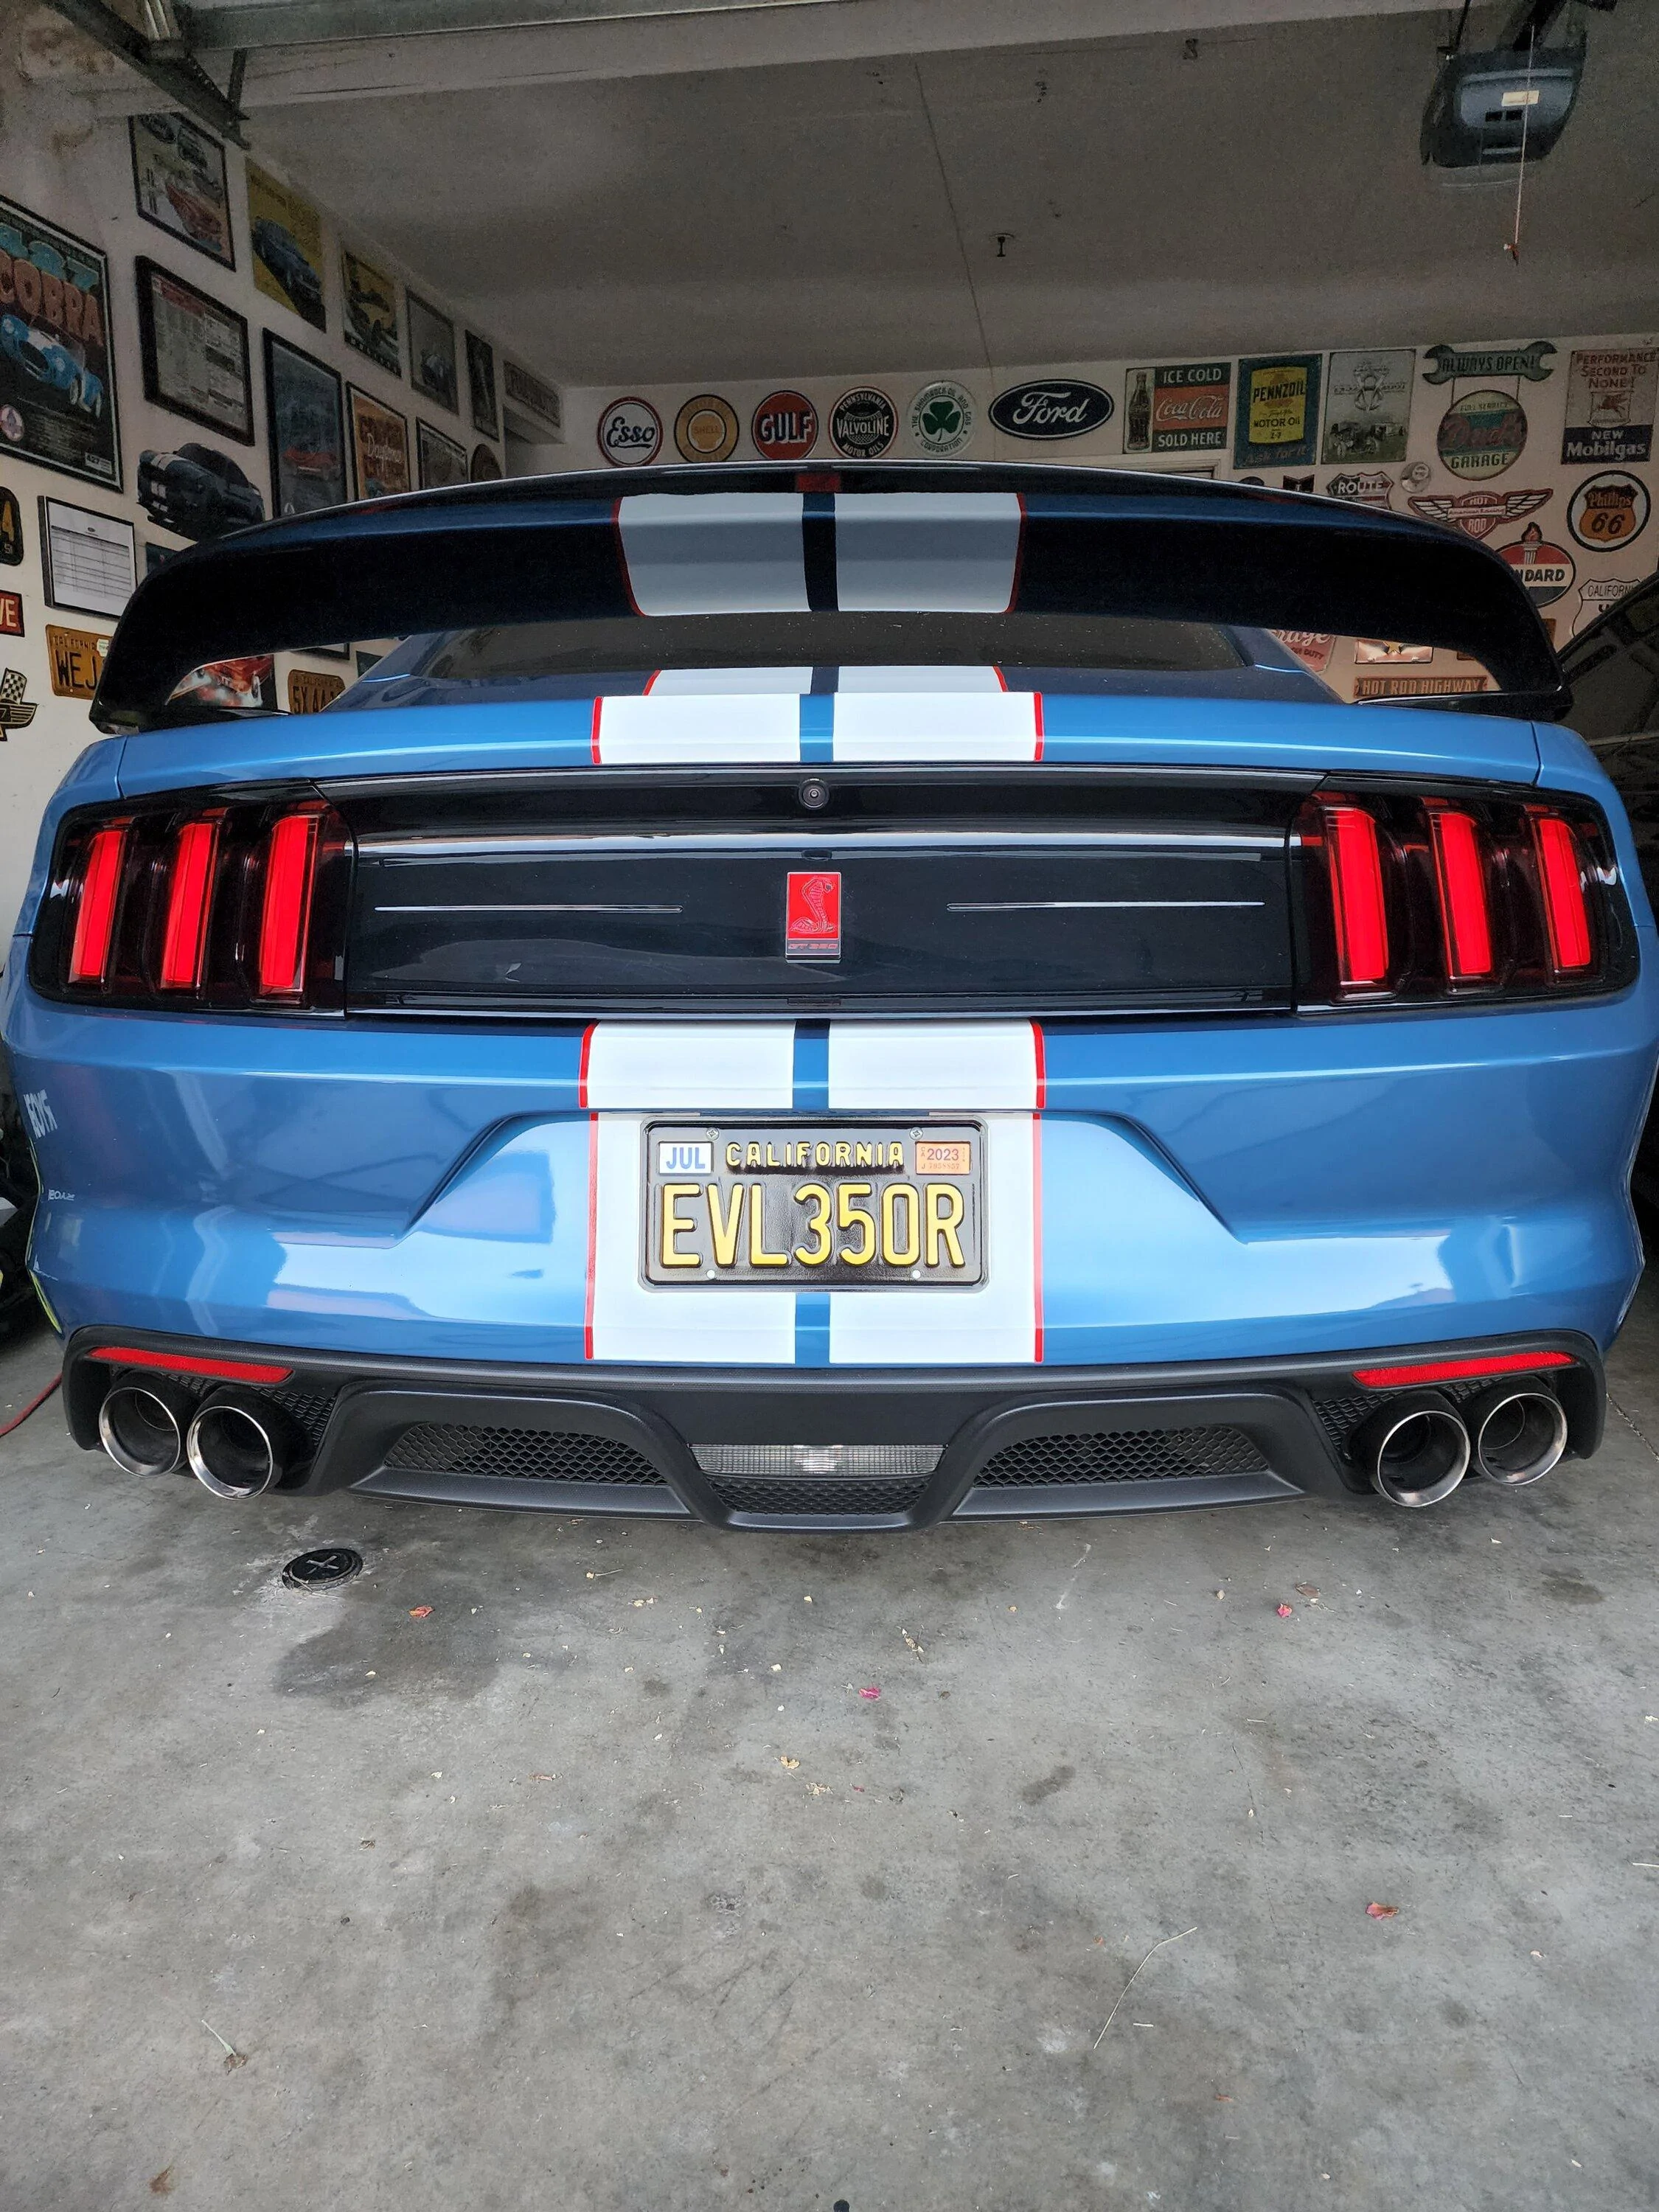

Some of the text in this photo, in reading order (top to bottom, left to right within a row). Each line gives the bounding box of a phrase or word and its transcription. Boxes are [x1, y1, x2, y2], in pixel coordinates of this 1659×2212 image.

[1442, 356, 1492, 372] ALWAYS
[1576, 352, 1657, 365] PERFORMANCE
[1164, 368, 1222, 384] ICE COLD
[1581, 366, 1627, 377] SECOND
[1253, 380, 1305, 403] PENNZOIL
[839, 392, 886, 411] PENNSYLVANIA
[1012, 392, 1090, 425] Ford
[759, 409, 813, 444] GULF
[836, 415, 889, 438] VALVOLINE
[1253, 418, 1286, 428] MOTOR
[606, 416, 656, 448] Esso
[1158, 431, 1222, 448] SOLD HERE
[1591, 430, 1625, 440] NEW
[842, 442, 885, 457] MOTOR OILS
[920, 437, 963, 453] CORPORATION
[1567, 441, 1646, 462] Mobilgas
[1451, 453, 1509, 469] GARAGE
[1338, 480, 1384, 495] ROUTE
[1469, 496, 1488, 504] HOT
[1587, 492, 1632, 507] Phillips
[1468, 518, 1486, 533] ROD
[1591, 512, 1624, 534] 66
[1516, 569, 1565, 582] NDARD
[1587, 584, 1635, 597] CALIFORN
[1363, 678, 1481, 695] HOT ROD HIGHWAY
[666, 1147, 706, 1169] JUL
[726, 1141, 905, 1167] CALIFORNIA
[927, 1148, 959, 1161] 2023
[662, 1183, 965, 1267] EVL350R
